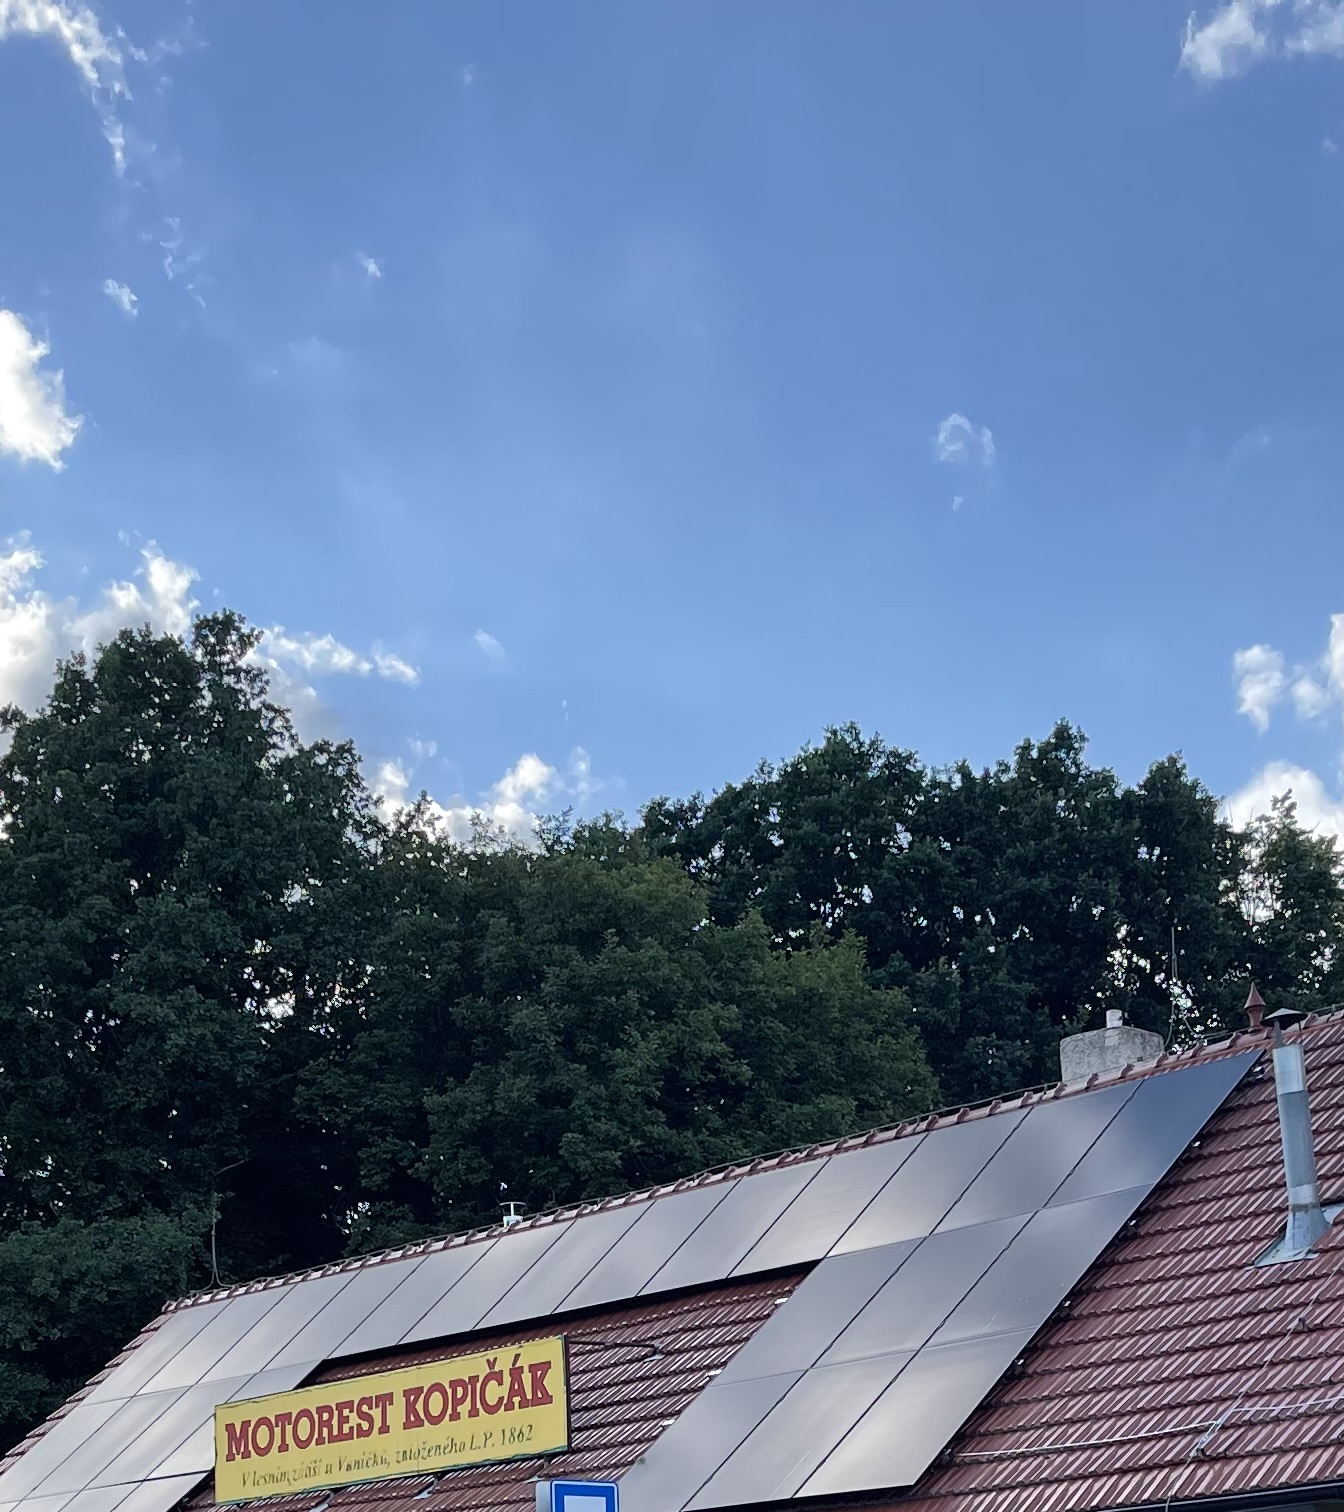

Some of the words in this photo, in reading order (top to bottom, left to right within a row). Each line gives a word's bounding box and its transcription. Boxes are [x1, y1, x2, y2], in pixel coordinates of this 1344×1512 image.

[225, 1391, 394, 1463] MOTOREST
[402, 1353, 554, 1431] KOPIČÁK
[500, 1424, 534, 1446] 1862
